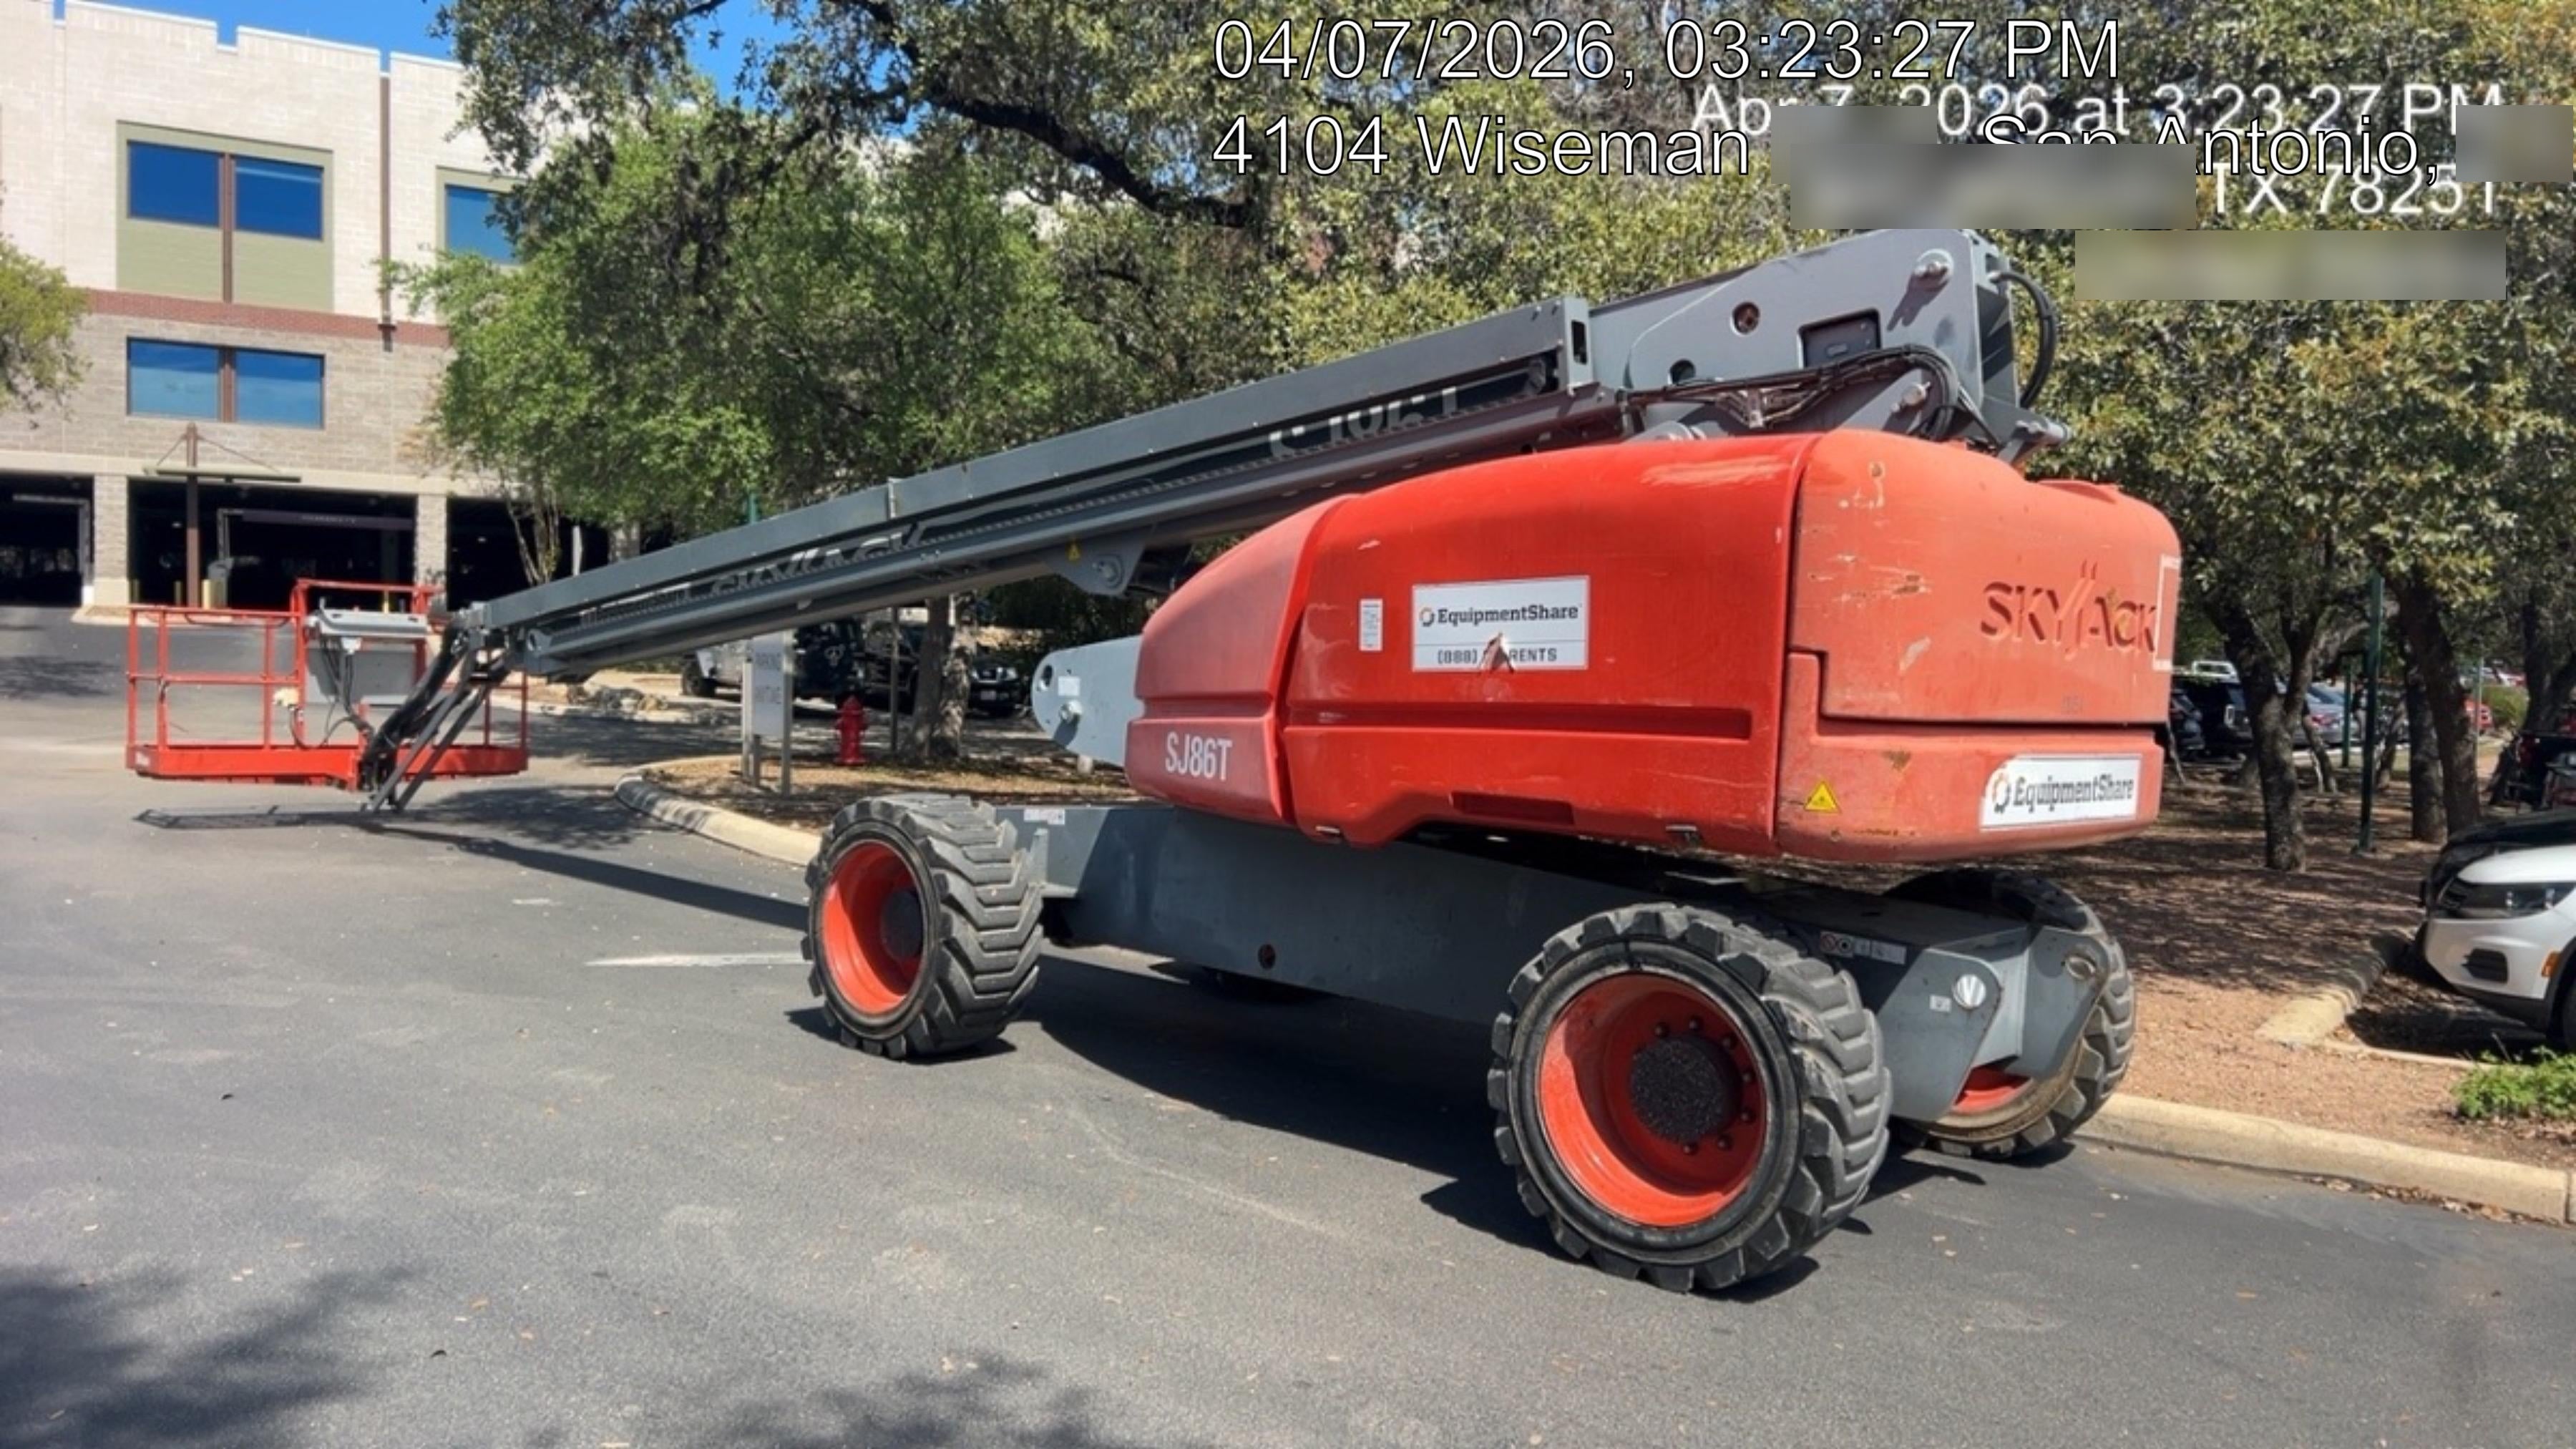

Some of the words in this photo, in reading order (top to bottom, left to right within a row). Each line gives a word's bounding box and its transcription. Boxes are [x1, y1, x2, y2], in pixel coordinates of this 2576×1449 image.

[1437, 605, 1579, 627] EquipmentShare
[1980, 560, 2157, 660] SKYJACK
[1165, 731, 1233, 781] SJ86T
[2013, 774, 2135, 814] EquipmentShare
